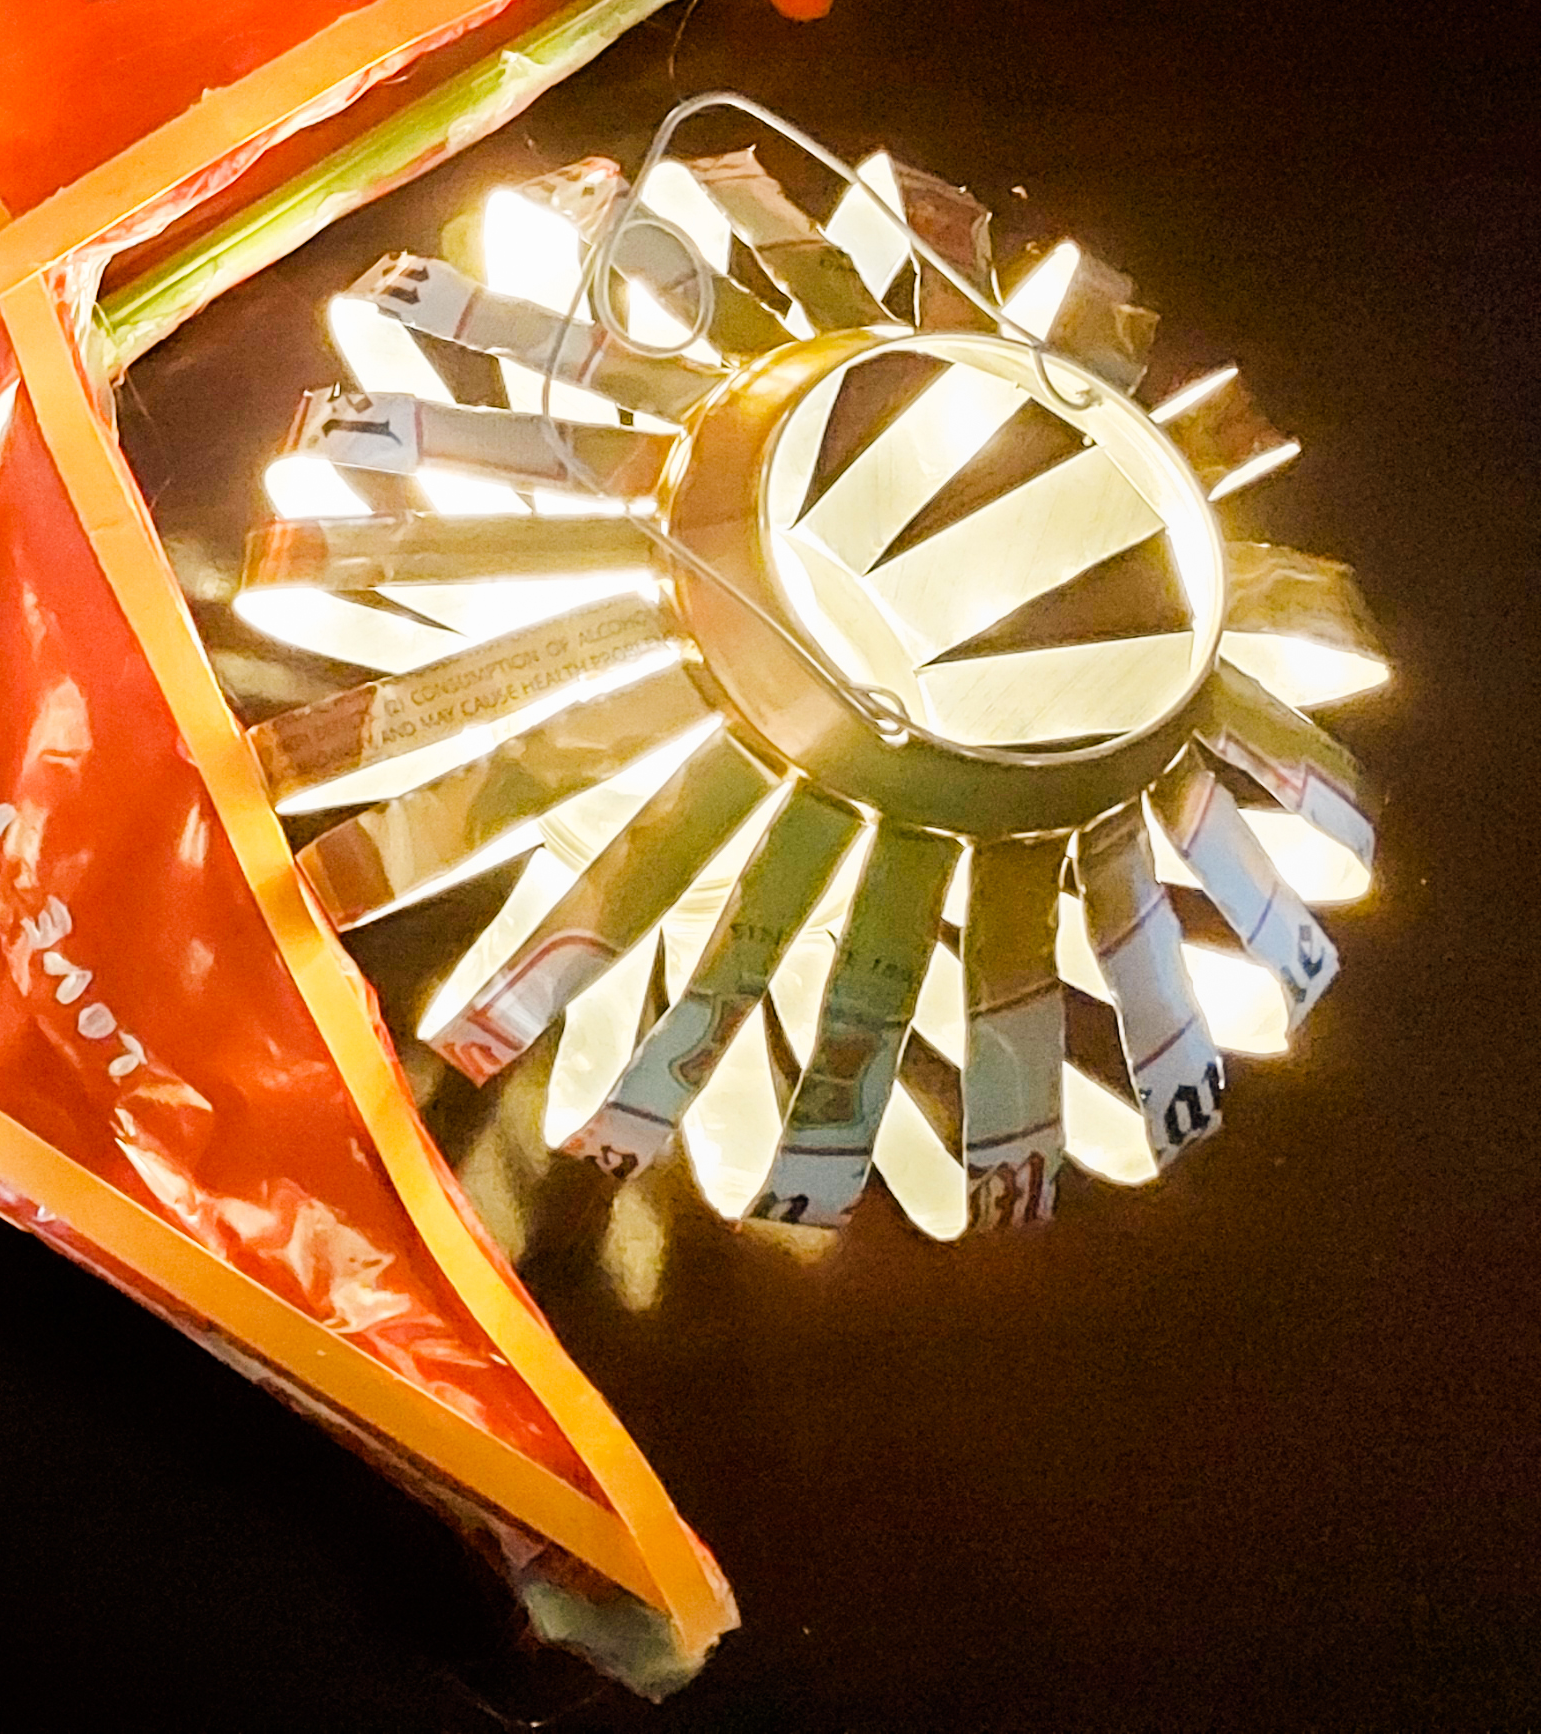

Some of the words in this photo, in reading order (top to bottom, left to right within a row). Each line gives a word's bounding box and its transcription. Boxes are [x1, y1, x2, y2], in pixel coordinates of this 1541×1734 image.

[411, 648, 540, 707] CONSUMPTION
[461, 686, 515, 719] CAUSE
[22, 894, 147, 1078] LOVE
